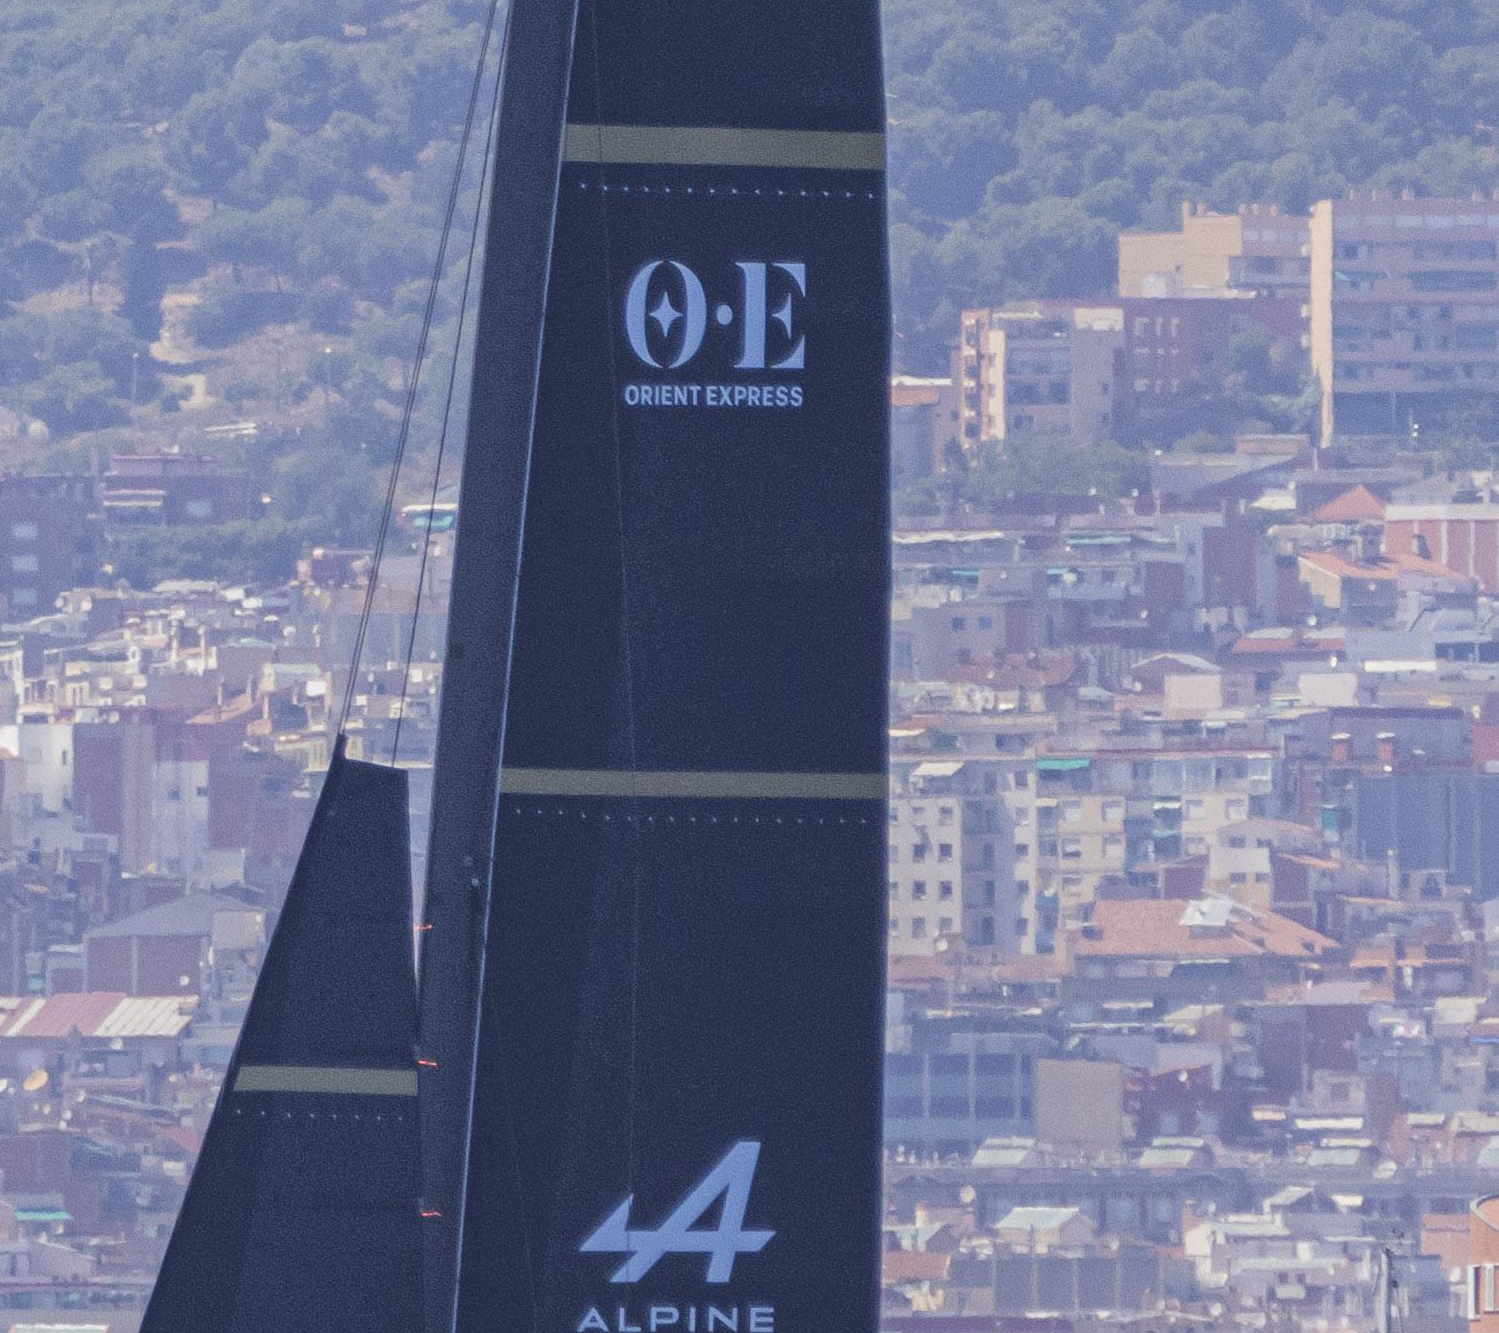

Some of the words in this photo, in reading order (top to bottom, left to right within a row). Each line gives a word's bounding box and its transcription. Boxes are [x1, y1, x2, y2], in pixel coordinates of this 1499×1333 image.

[624, 384, 702, 406] ORIENT
[705, 385, 803, 407] EXPRESS
[577, 1306, 775, 1333] ALPINE
